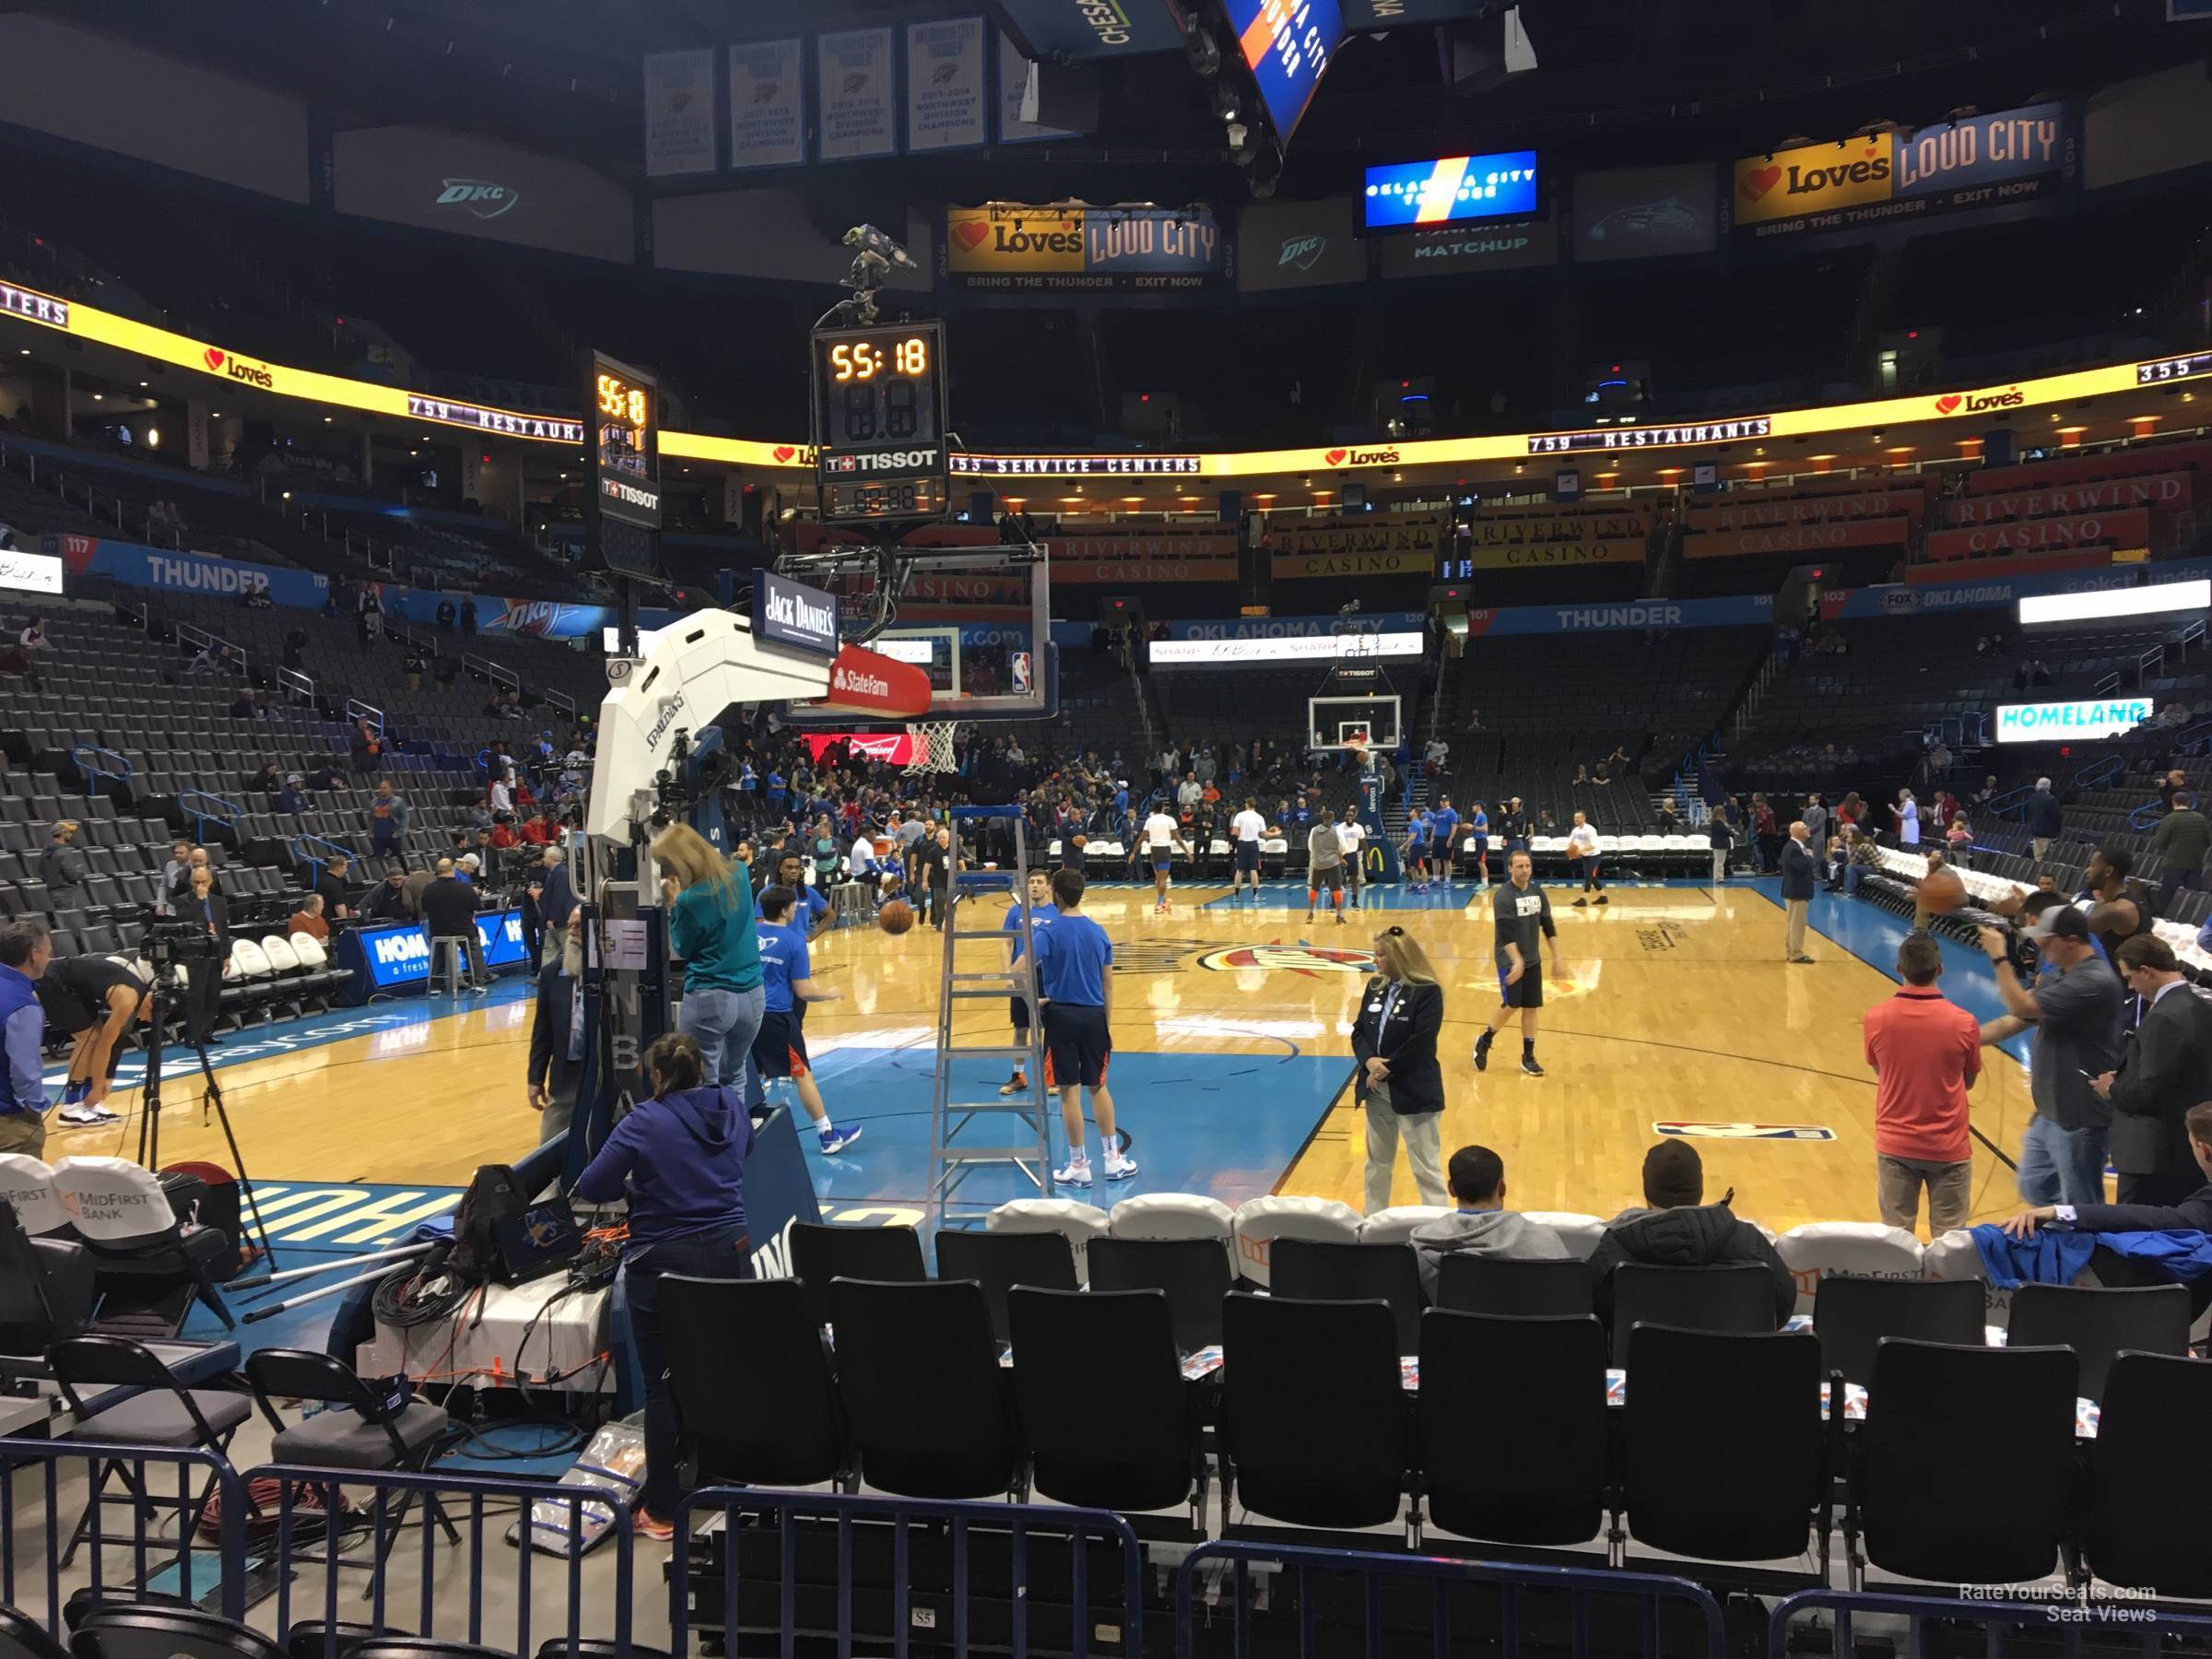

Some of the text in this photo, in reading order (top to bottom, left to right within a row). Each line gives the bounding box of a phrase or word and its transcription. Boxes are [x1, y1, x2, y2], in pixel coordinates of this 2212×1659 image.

[915, 98, 976, 112] NORTHWEST
[924, 109, 968, 121] DIVISION
[917, 118, 976, 131] CHAMPIONS
[1900, 124, 1976, 189] LOUD
[1988, 119, 2056, 163] CITY
[1366, 169, 1535, 196] OKLAA CITY
[436, 184, 504, 203] OKC
[1404, 185, 1497, 206] TDER
[1756, 181, 2041, 237] BRING THE THUNDER EXIT NOW
[1091, 219, 1152, 265] LOUD
[1162, 219, 1216, 263] CITY
[1277, 236, 1318, 265] OKC
[1415, 237, 1529, 258] MATCHUP
[968, 277, 1203, 288] BRING THE THUNDER EXIT NOW
[0, 285, 65, 324] TERS
[2140, 359, 2189, 382] 355
[411, 398, 448, 419] 759
[1531, 420, 1769, 452] 759 RESTAURANTS
[856, 450, 937, 471] TISSOT
[998, 459, 1089, 473] SERVICE
[1108, 458, 1198, 473] CENTERS
[618, 483, 659, 510] TISSOT
[1959, 479, 2182, 523] RIVERWIND
[1721, 497, 1890, 526] RIVERWIND
[1279, 530, 1430, 550] RIVERWIND
[1483, 519, 1641, 540] RIVERWIND
[1739, 528, 1848, 548] CASINO
[1969, 521, 2103, 551] CASINO
[66, 537, 89, 553] 117
[1065, 540, 1211, 556] RIVERWIND
[1507, 546, 1608, 563] CASINO
[147, 556, 270, 593] THUNDER
[1096, 564, 1188, 581] CASINO
[1305, 556, 1400, 574] CASINO
[904, 580, 989, 598] ASINO
[2065, 566, 2209, 593] @okctunder
[1823, 591, 1848, 602] 102
[1888, 584, 2013, 608] FOX OKLAHOMA
[766, 587, 833, 637] JACK DANIEL'S
[1404, 613, 1426, 623] 120
[1469, 610, 1489, 620] 101
[1557, 606, 1682, 629] THUNDER
[1187, 618, 1385, 641] OKLAHOMA CTY
[645, 691, 685, 754] SPALDING
[2002, 702, 2147, 728] HOMELAND
